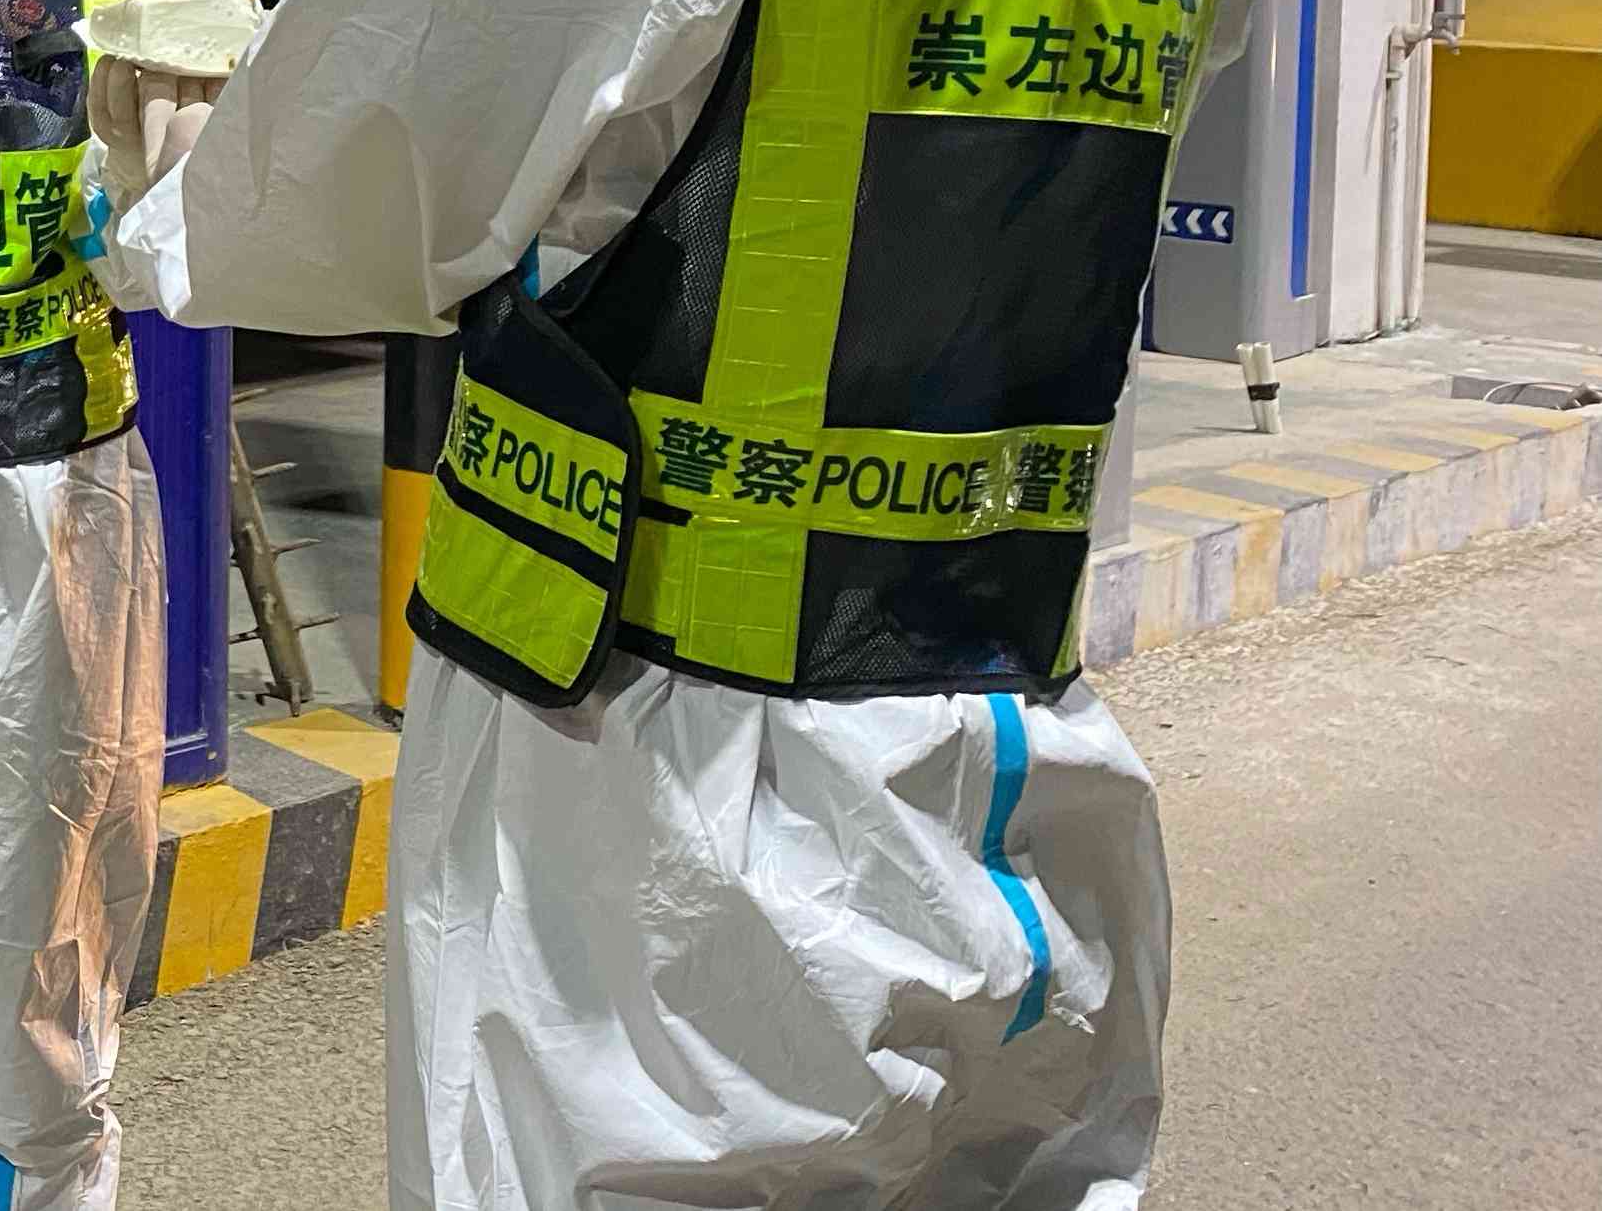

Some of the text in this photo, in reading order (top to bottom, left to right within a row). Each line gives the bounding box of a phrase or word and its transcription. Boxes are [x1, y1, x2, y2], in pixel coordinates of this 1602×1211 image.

[492, 428, 623, 536] POLICE
[654, 416, 814, 509] 警察
[812, 454, 989, 514] POLICE
